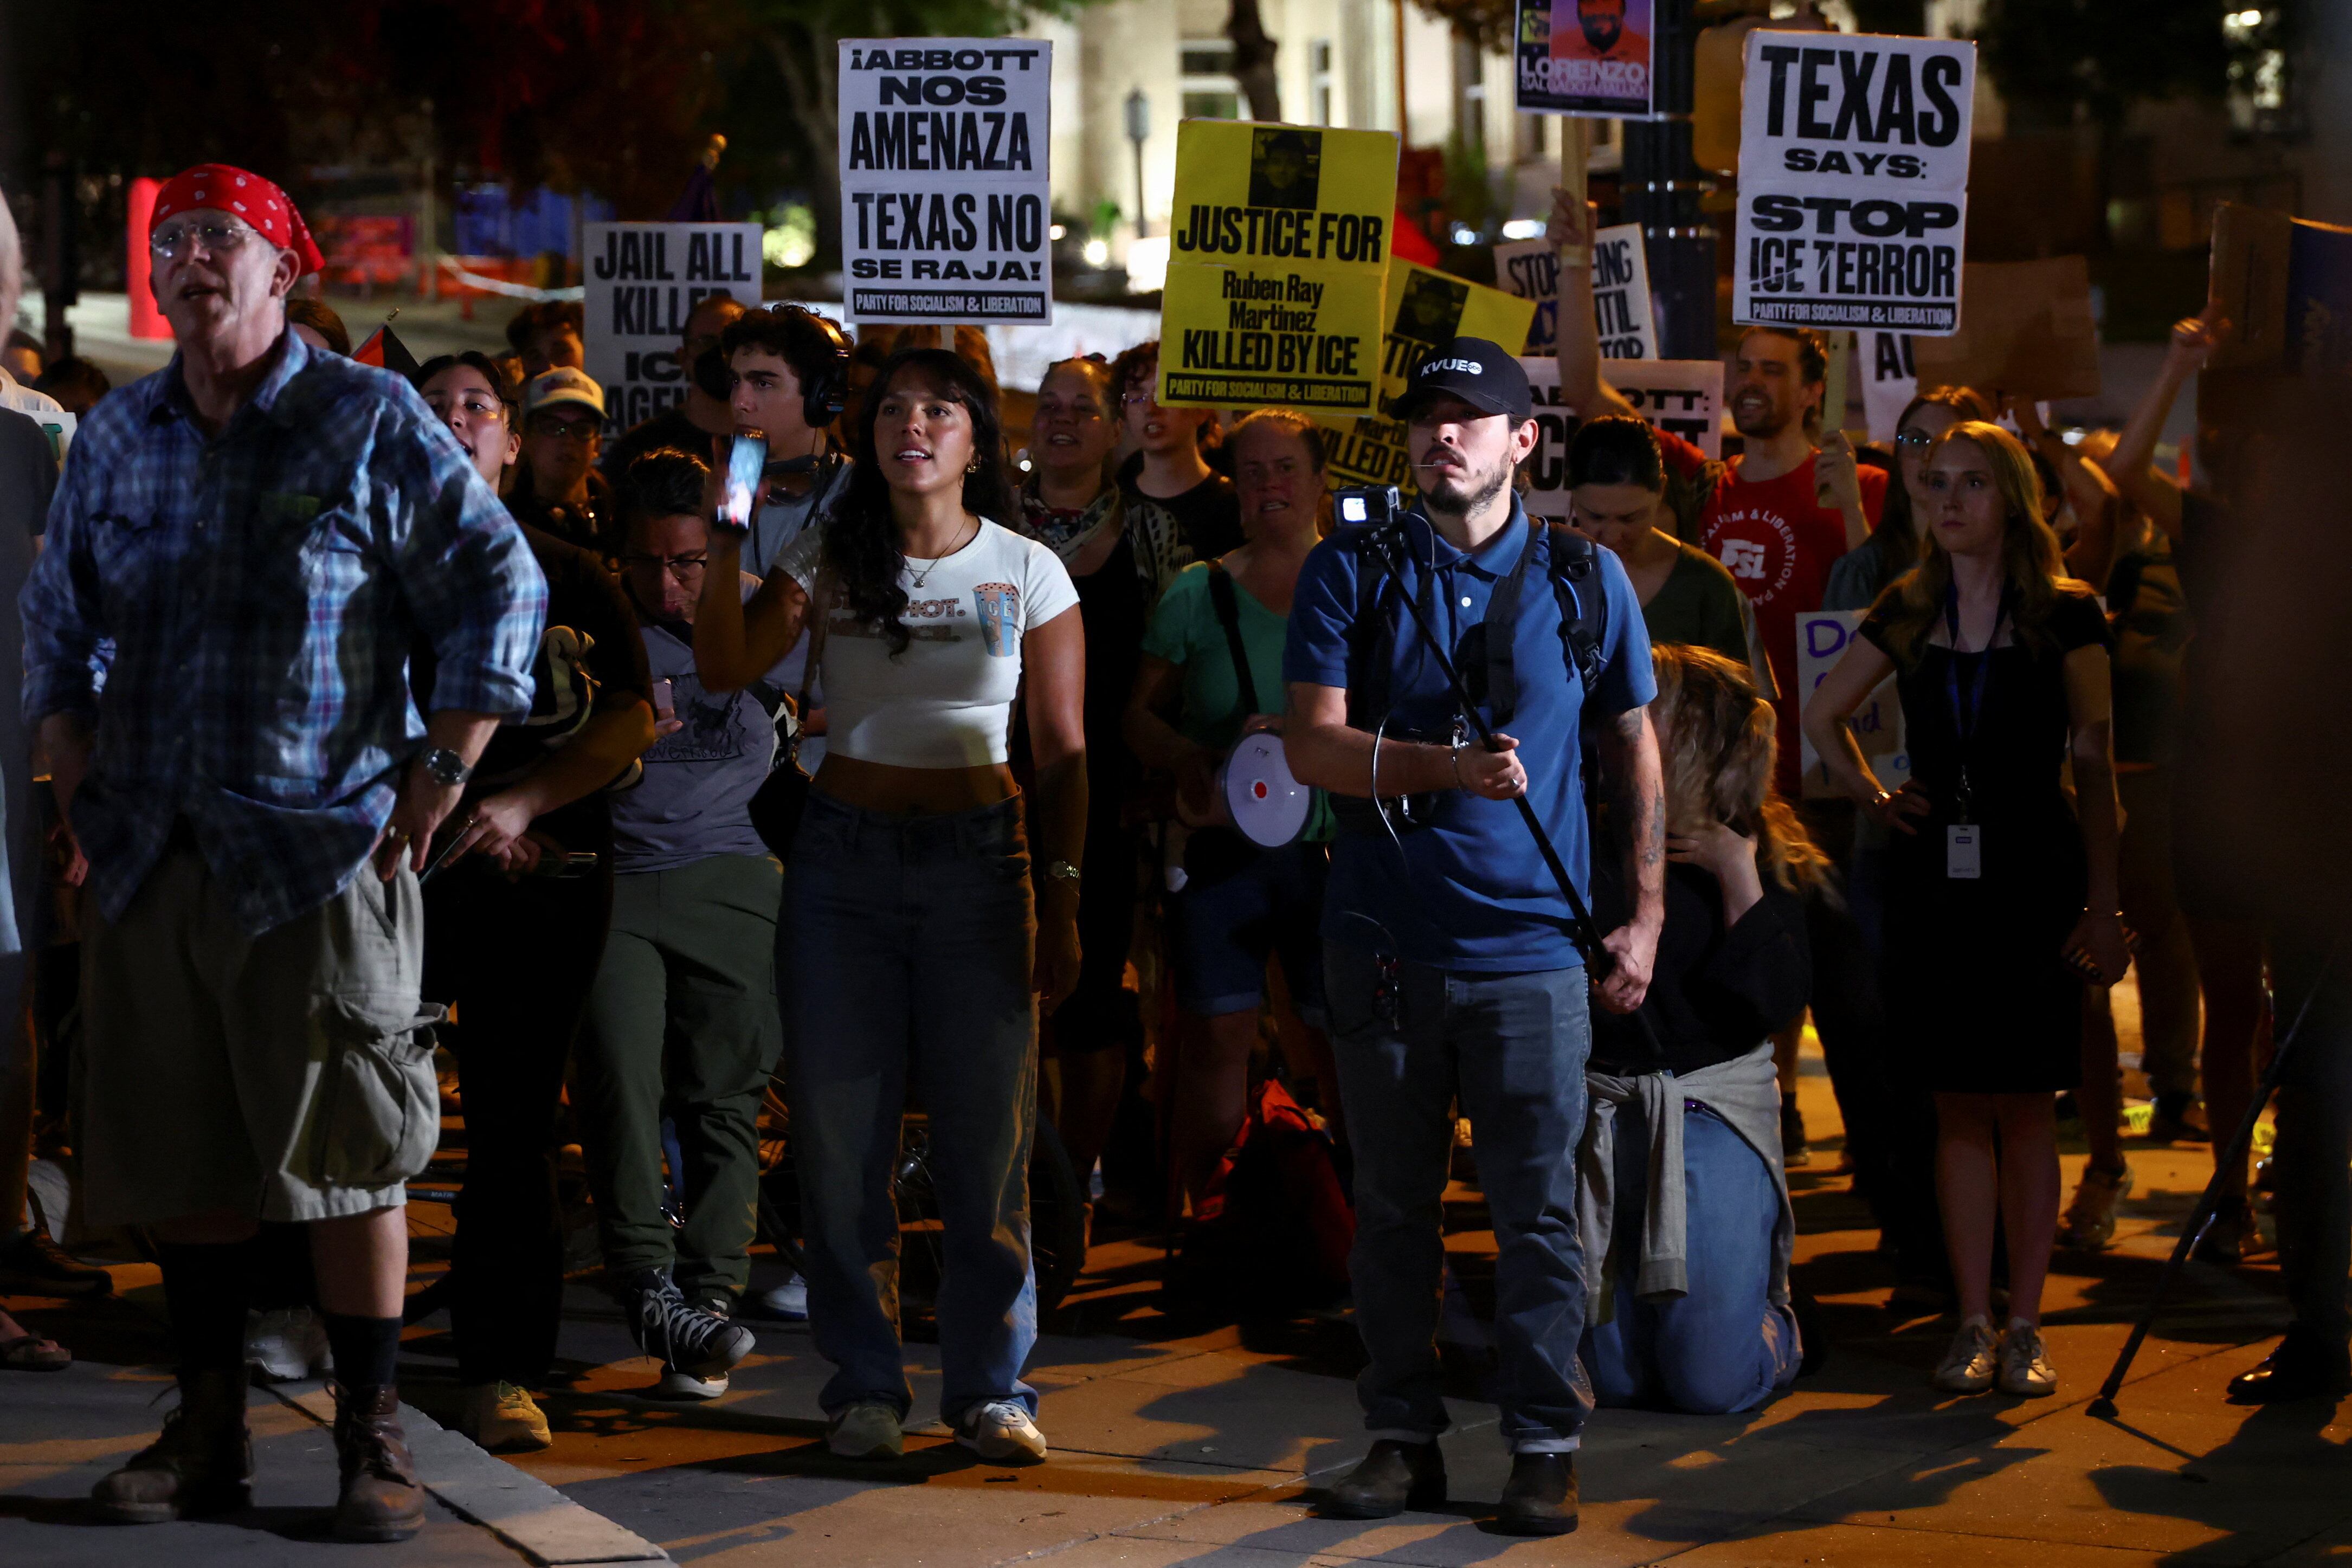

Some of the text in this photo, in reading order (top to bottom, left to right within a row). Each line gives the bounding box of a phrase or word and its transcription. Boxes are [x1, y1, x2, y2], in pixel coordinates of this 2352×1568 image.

[1521, 56, 1645, 83] LORENZO
[880, 76, 1006, 106] NOS
[1761, 46, 1962, 148] TEXAS
[849, 112, 1032, 170] AMENAZA
[1784, 148, 1927, 178] SAYS:
[852, 193, 1042, 252] TEXAS NO
[1177, 205, 1383, 263] JUSTICE FOR
[1750, 195, 1959, 237] STOP
[594, 231, 751, 281] JAIL ALL
[852, 258, 1041, 281] SE RAJA!
[1749, 237, 1955, 297] ICE TERROR
[855, 293, 1042, 314] PARTY FOR SOCIALISM & LIBERATION
[1222, 270, 1324, 309] Ruben Ray
[613, 287, 732, 335] KILL
[1229, 301, 1317, 332] Martinez
[1753, 302, 1953, 325] PARTY FOR SOCIALISM & LIBERATION
[625, 351, 684, 382] IC
[1182, 328, 1273, 371] KILLED
[1277, 332, 1313, 373] BY
[1316, 335, 1359, 376] ICE
[1421, 358, 1468, 377] KVUE
[1169, 378, 1205, 396] PARTY
[1206, 380, 1226, 398] FOR
[1228, 381, 1285, 400] SOCIALISM
[1287, 383, 1301, 399] &
[1304, 384, 1368, 403] LIBERATION
[1762, 510, 1796, 590] LIBERATION
